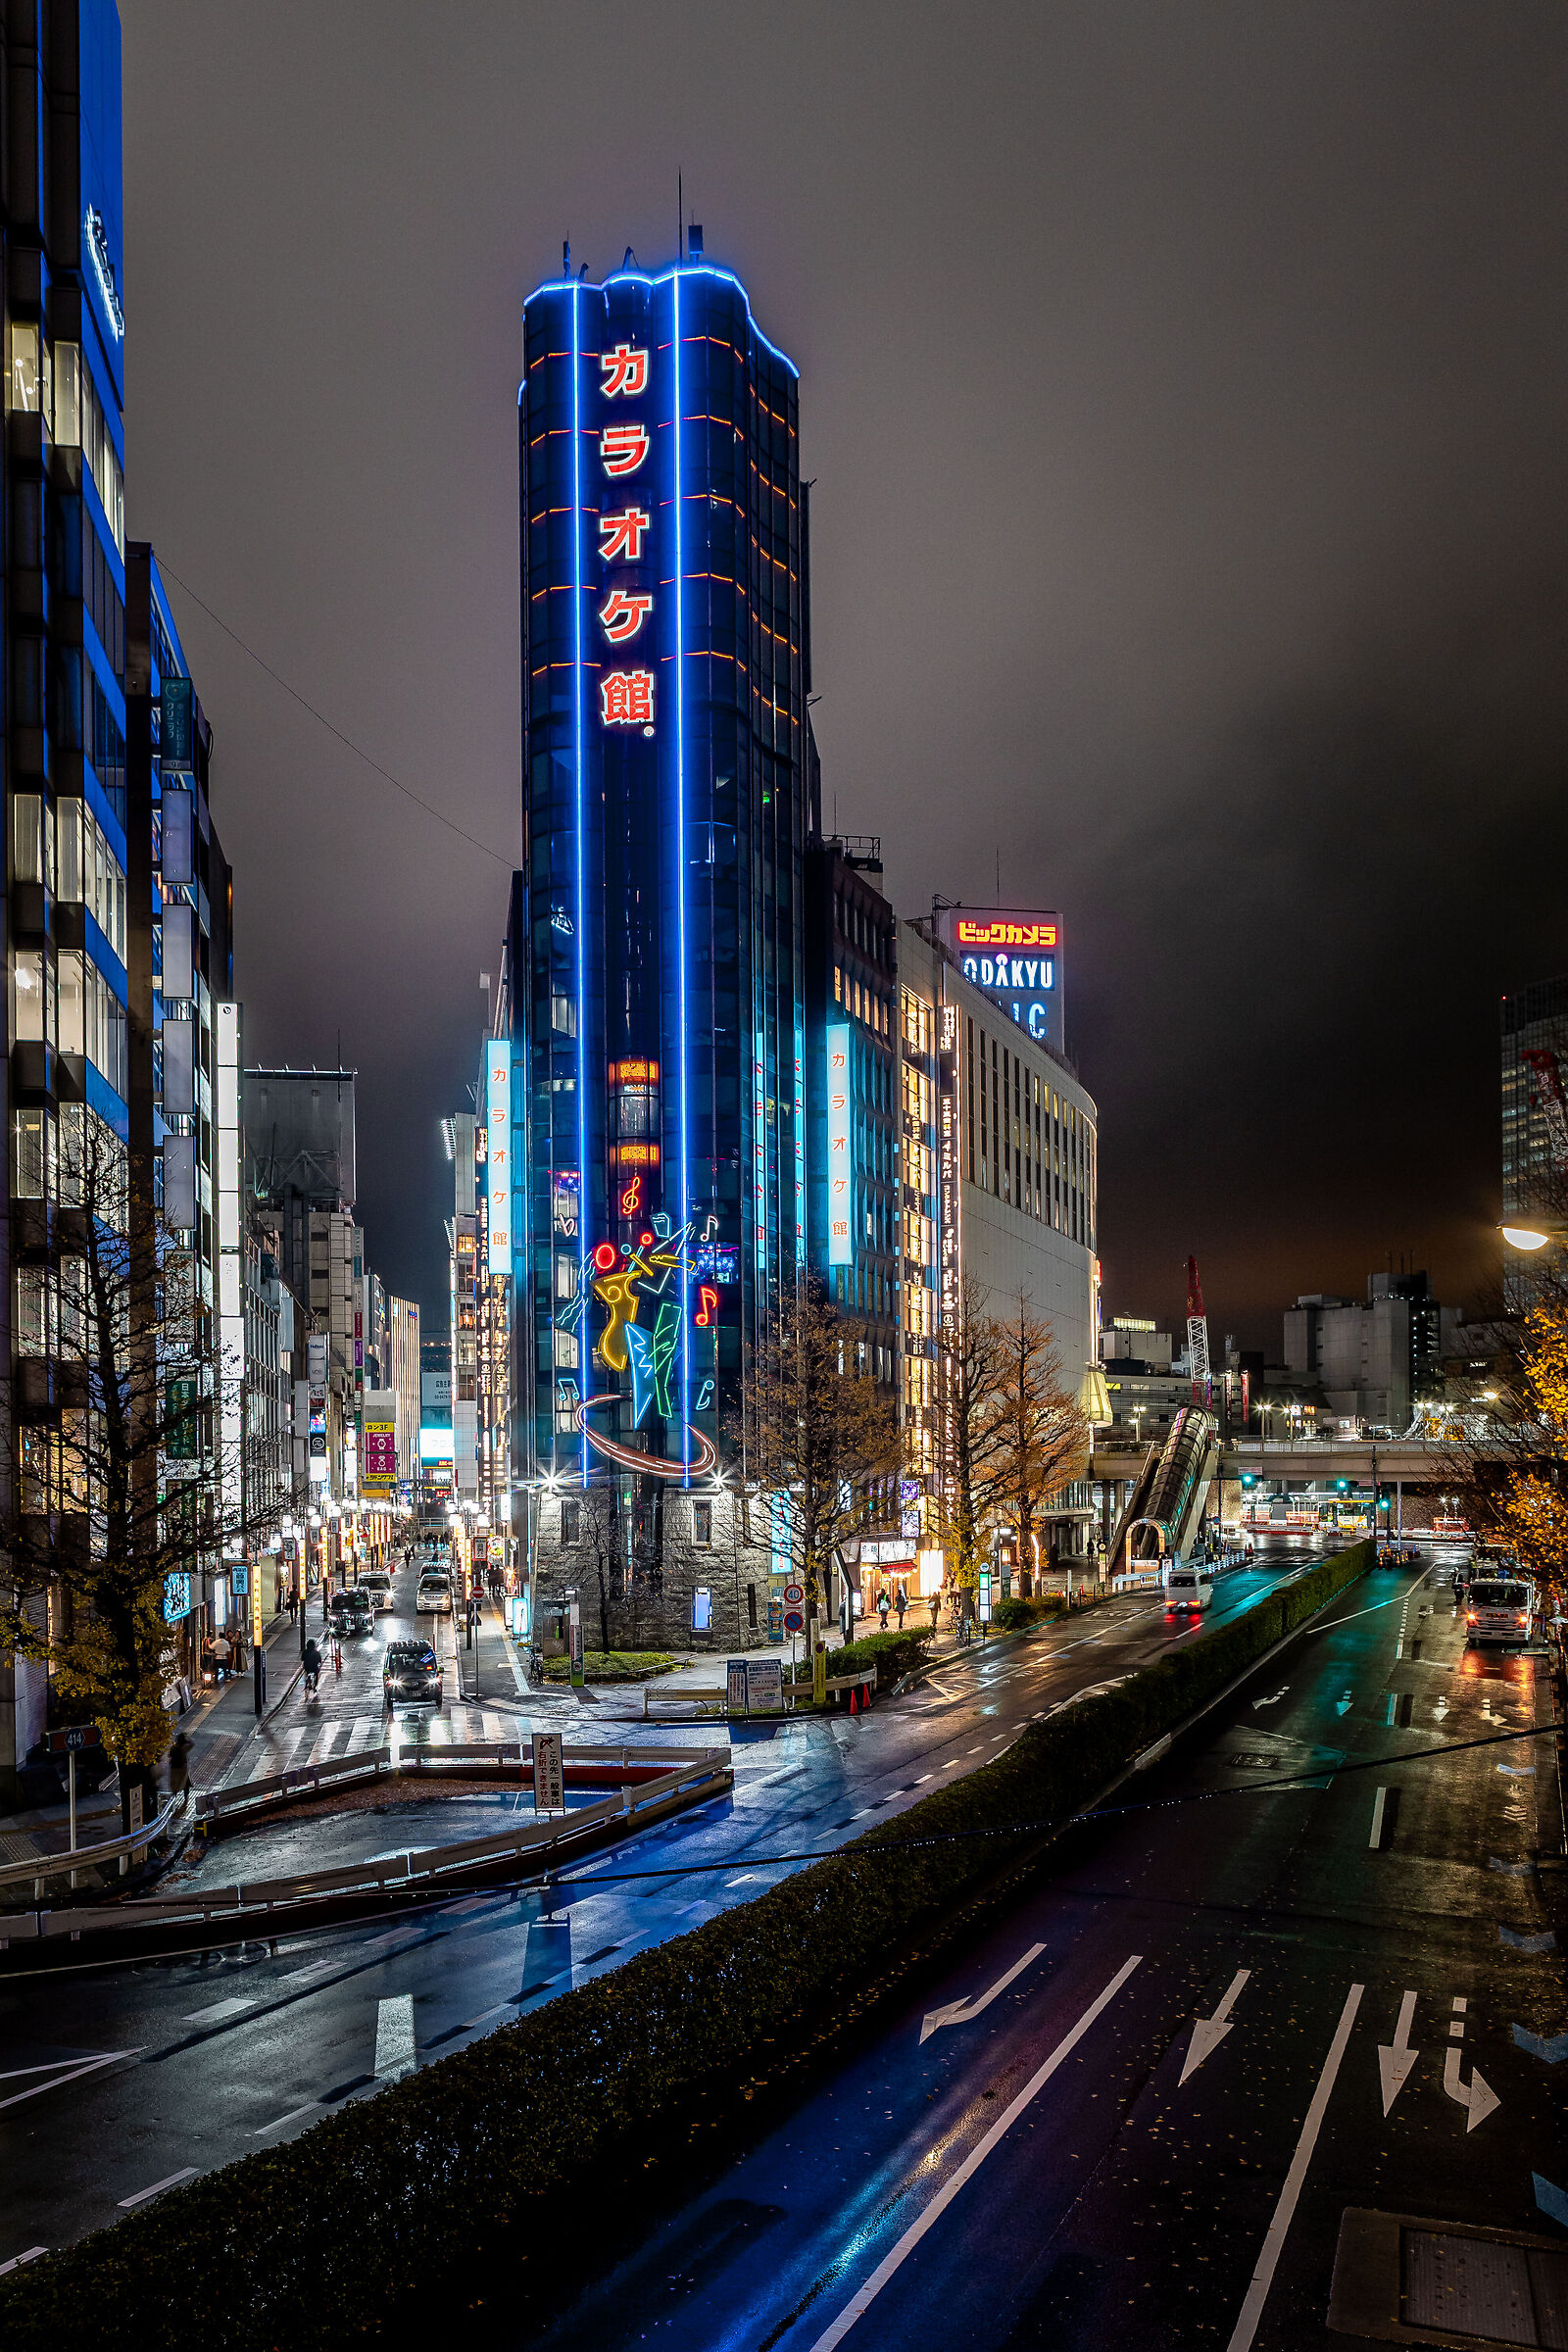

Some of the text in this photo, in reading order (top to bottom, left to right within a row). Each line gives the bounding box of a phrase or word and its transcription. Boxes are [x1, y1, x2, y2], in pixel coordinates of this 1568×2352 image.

[600, 344, 654, 725] カラオケ館
[958, 921, 1056, 947] ビックカメラ
[963, 955, 1053, 989] ODAKYU
[492, 1068, 508, 1246] カラオケ館
[831, 1053, 848, 1236] カラオケ館
[788, 1590, 800, 1599] 40
[68, 1732, 82, 1744] 414
[537, 1750, 549, 1806] 右折できません
[549, 1750, 561, 1806] この先一般車は
